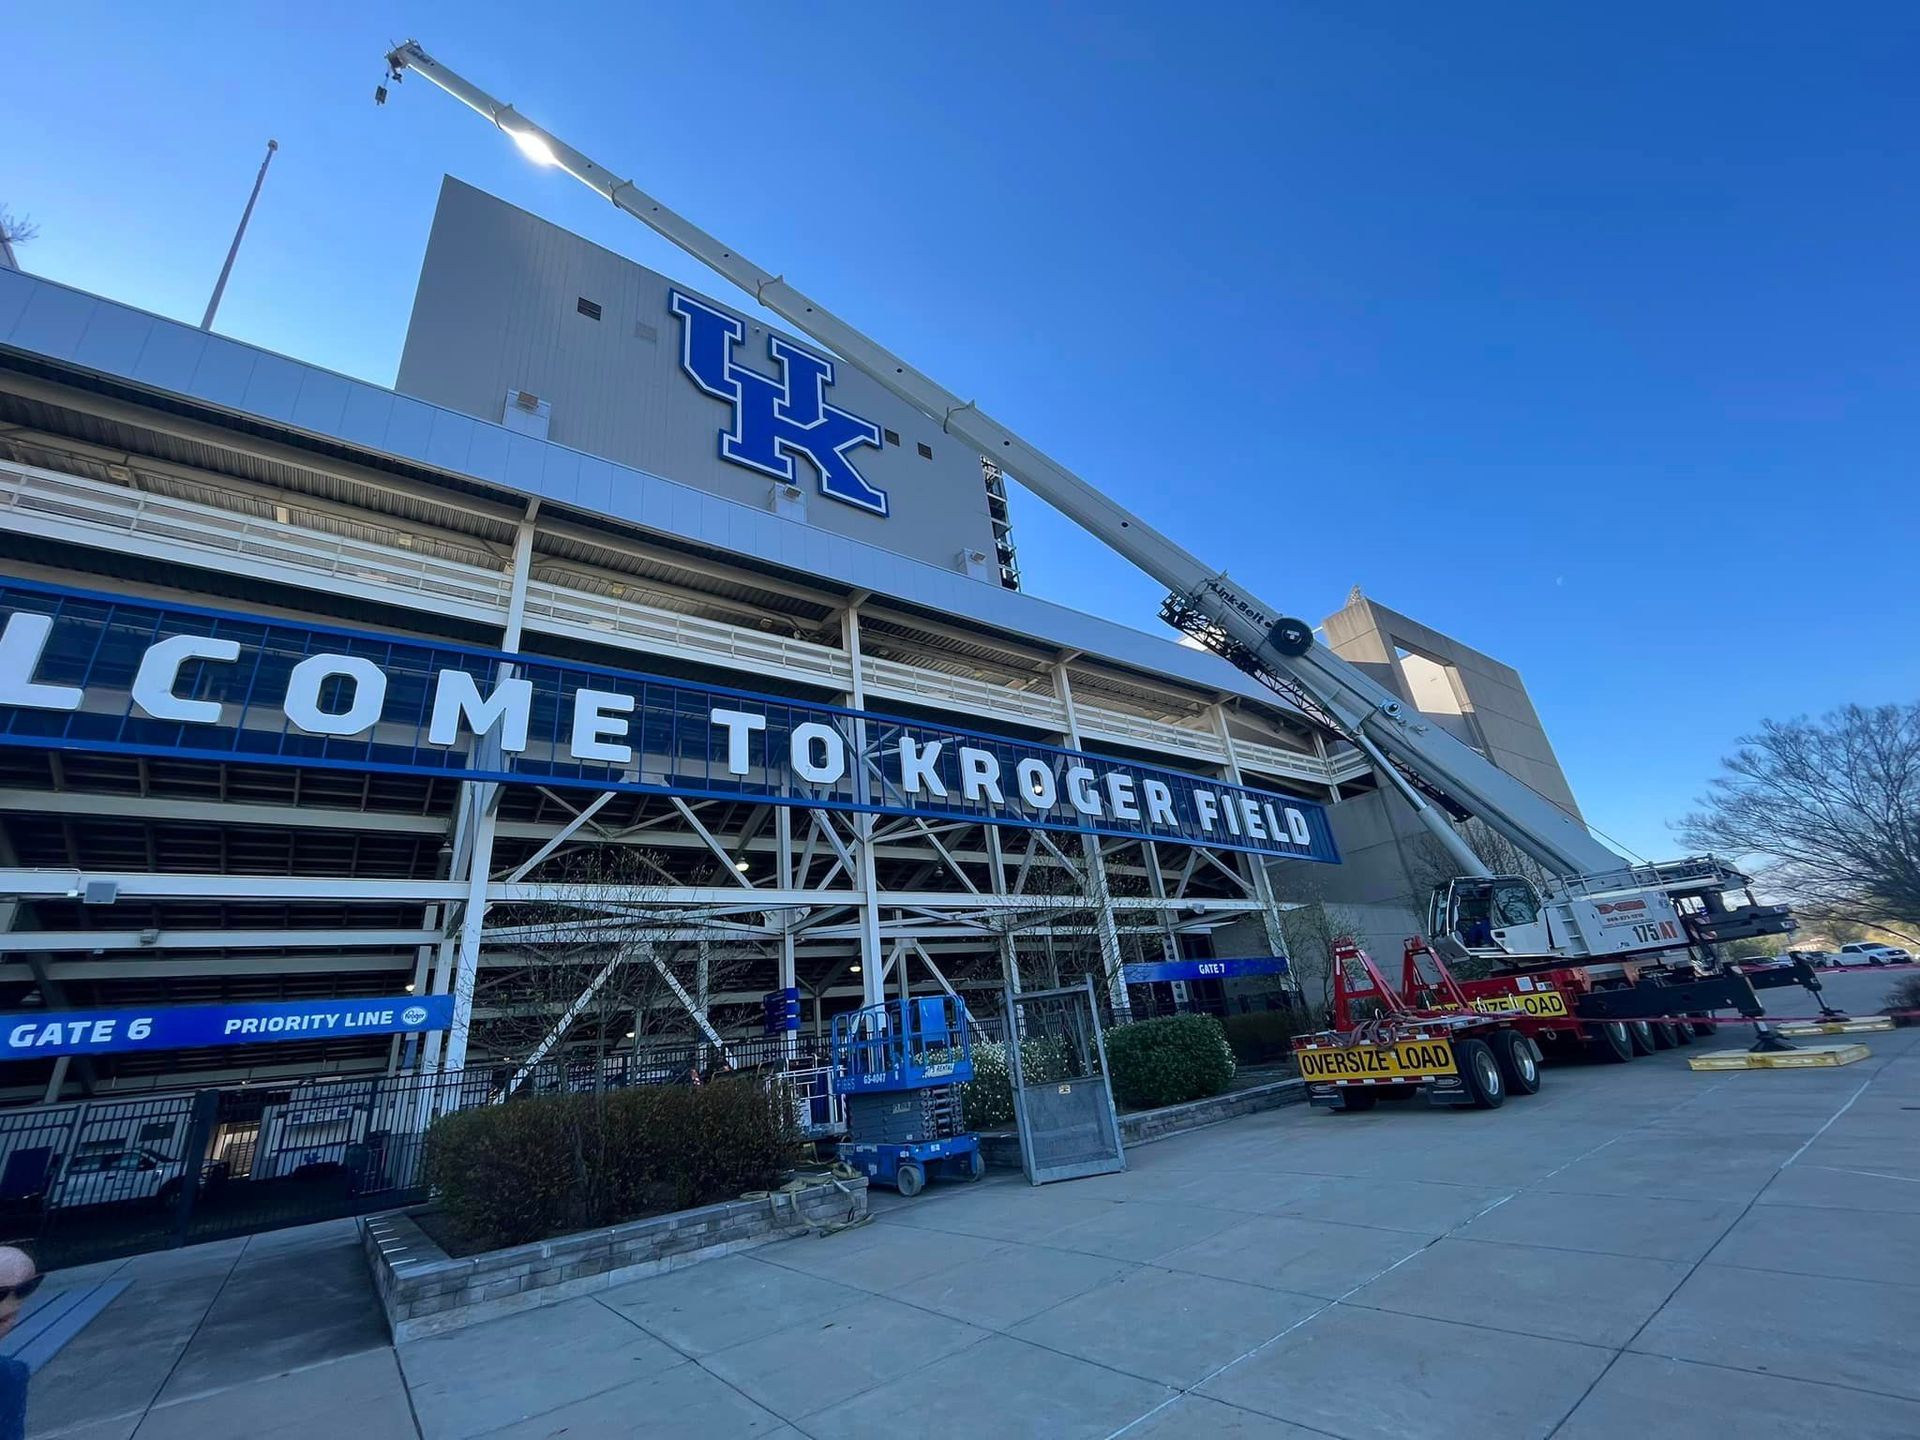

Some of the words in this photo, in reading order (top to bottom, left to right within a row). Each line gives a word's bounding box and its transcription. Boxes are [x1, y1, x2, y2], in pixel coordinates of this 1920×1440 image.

[710, 707, 844, 784] TO
[899, 736, 1179, 826] KROGER
[1192, 789, 1311, 847] FIELD
[1199, 963, 1219, 975] GATE
[1219, 963, 1226, 974] 7
[8, 1018, 115, 1048] GATE
[127, 1017, 153, 1041] 6
[224, 1013, 340, 1035] PRIORITY
[344, 1010, 393, 1028] LINE
[1302, 1050, 1389, 1076] OVERSIZE
[1398, 1045, 1450, 1069] LOAD
